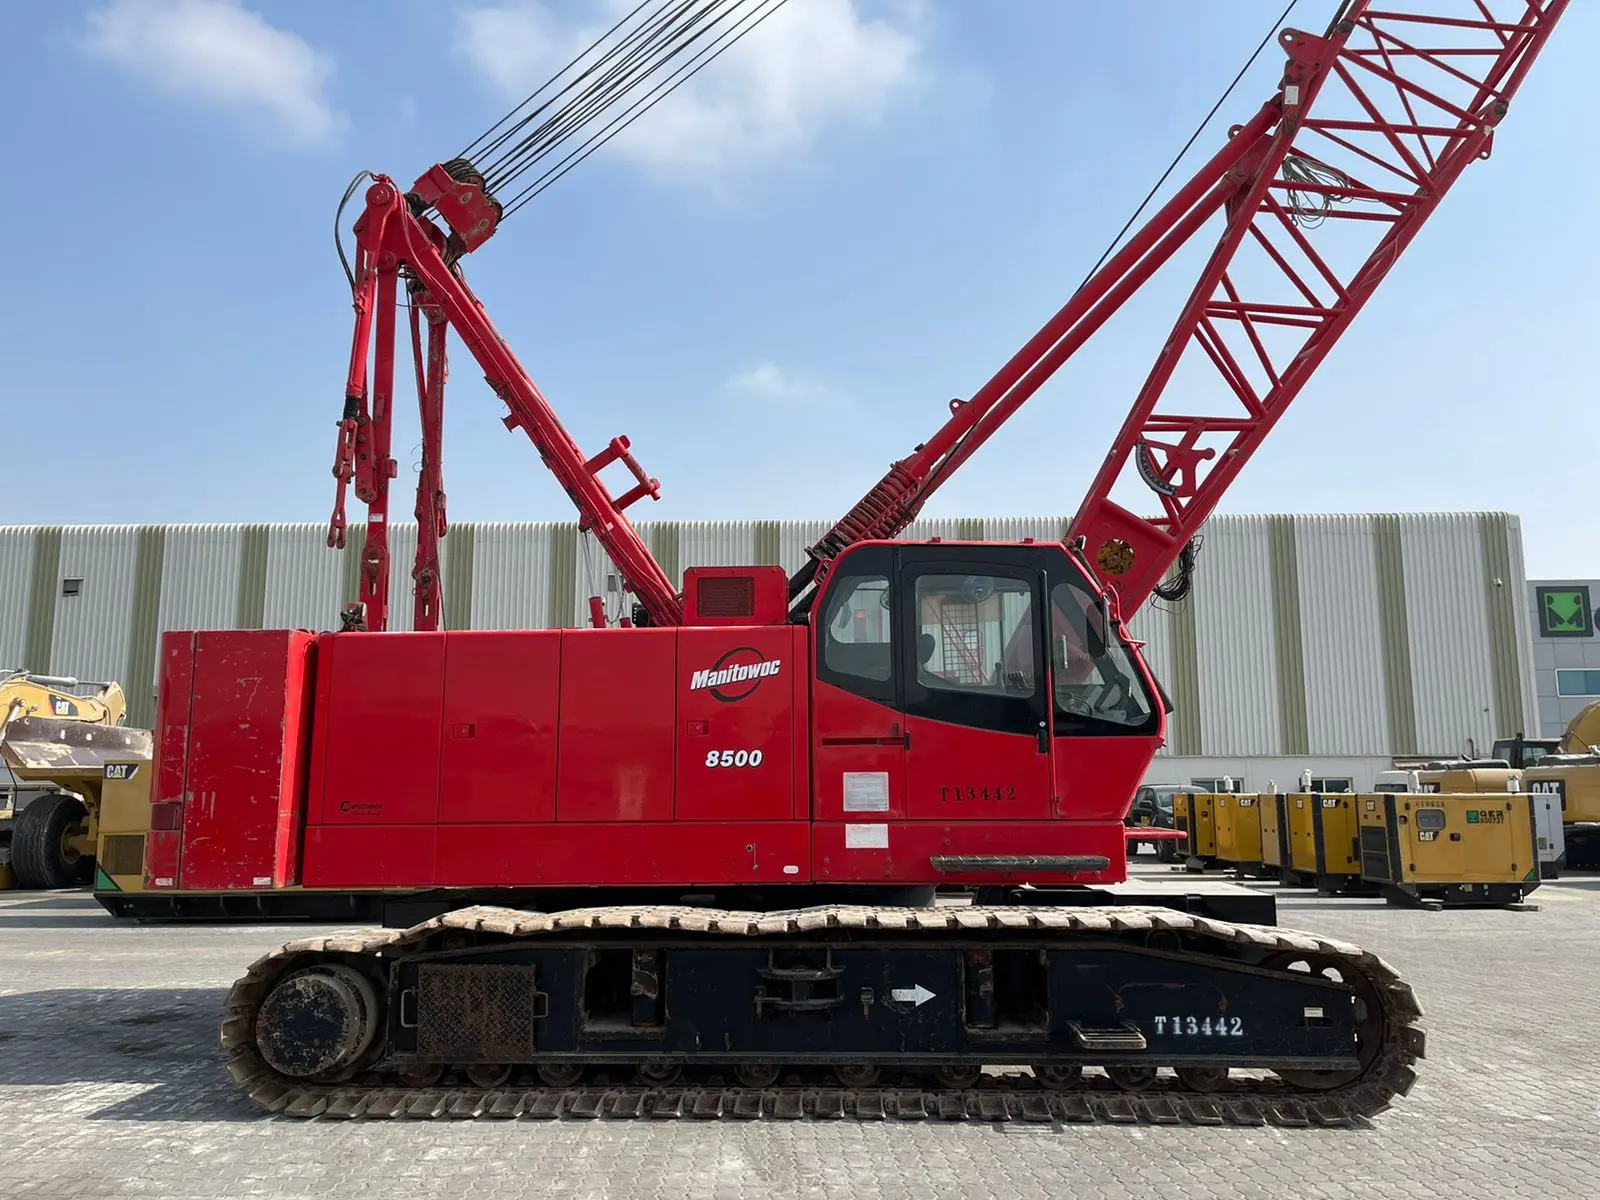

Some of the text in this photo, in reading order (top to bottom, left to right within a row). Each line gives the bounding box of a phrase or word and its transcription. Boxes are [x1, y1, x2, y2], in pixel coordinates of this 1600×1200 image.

[690, 659, 781, 691] Manitowoc
[55, 701, 69, 715] CAT
[705, 749, 763, 768] 8500
[106, 765, 127, 779] CAT
[939, 786, 1016, 801] T13442
[1322, 799, 1336, 808] CAT
[1420, 831, 1434, 841] CAT
[1154, 1015, 1244, 1036] T13442
